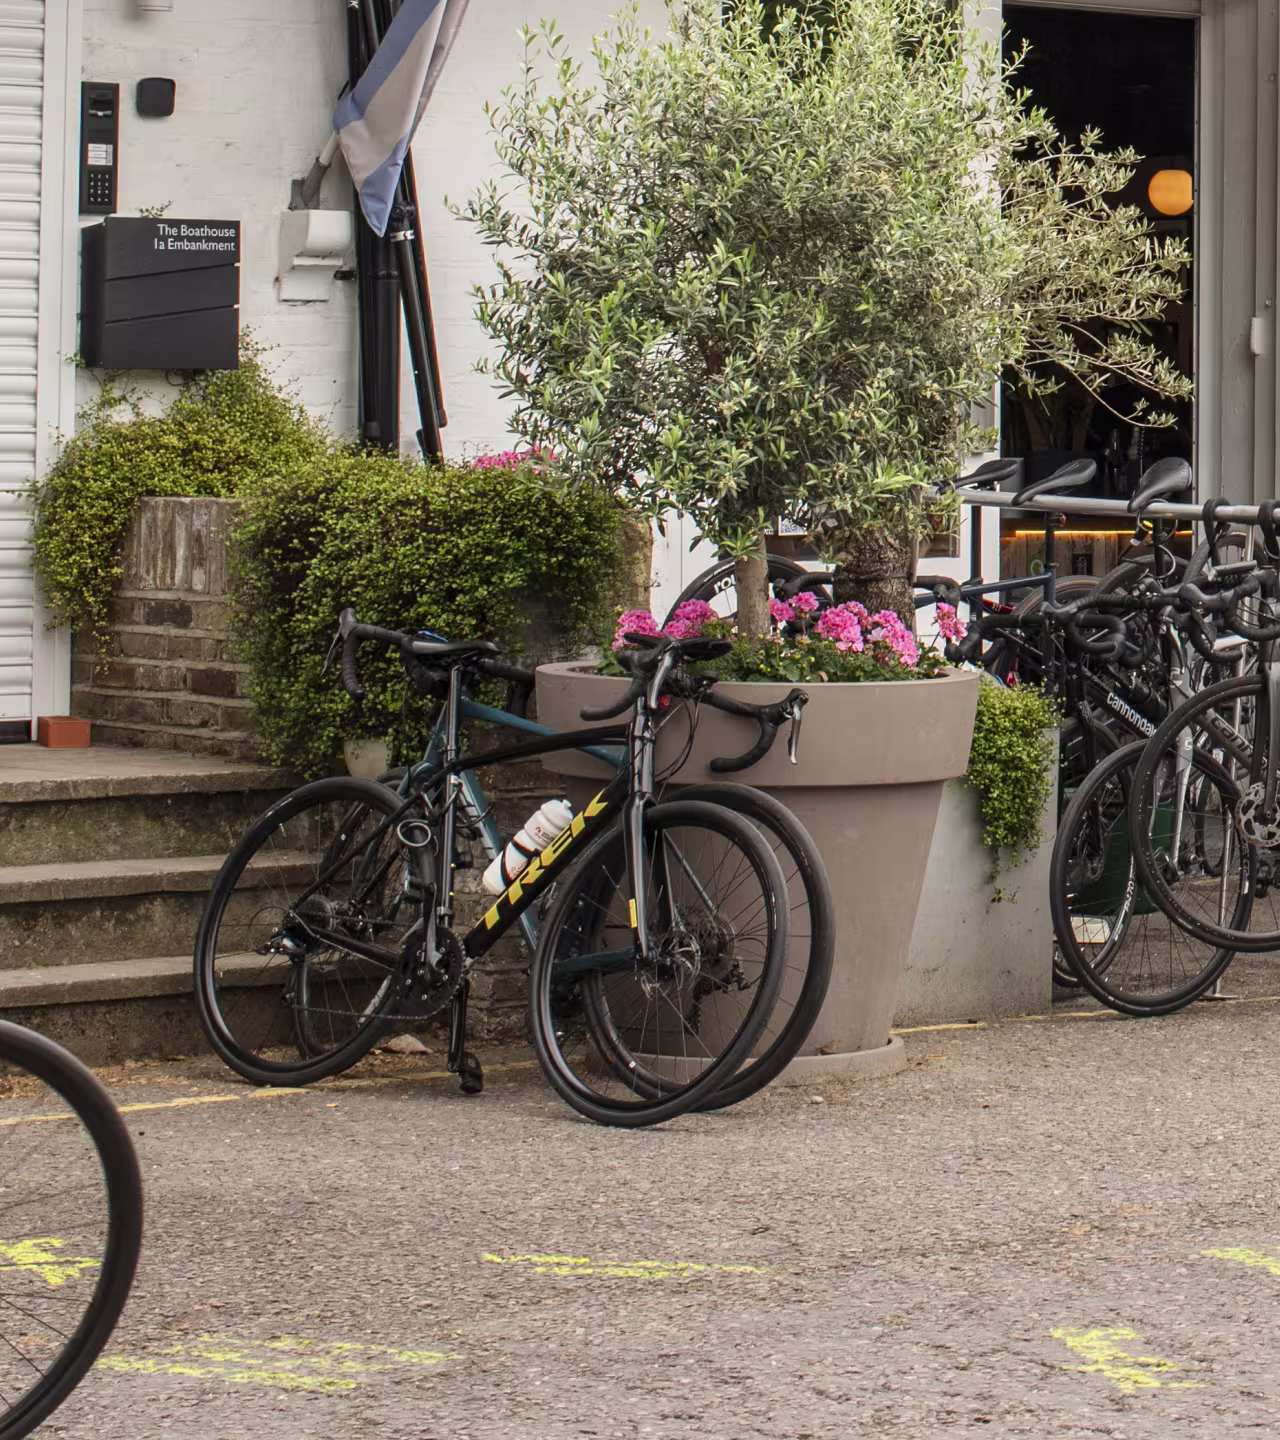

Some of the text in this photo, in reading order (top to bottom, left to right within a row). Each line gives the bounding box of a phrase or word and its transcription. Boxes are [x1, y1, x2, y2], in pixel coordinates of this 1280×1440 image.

[157, 224, 236, 237] The Boathouse
[168, 238, 236, 251] Embankment
[474, 788, 608, 930] TREK
